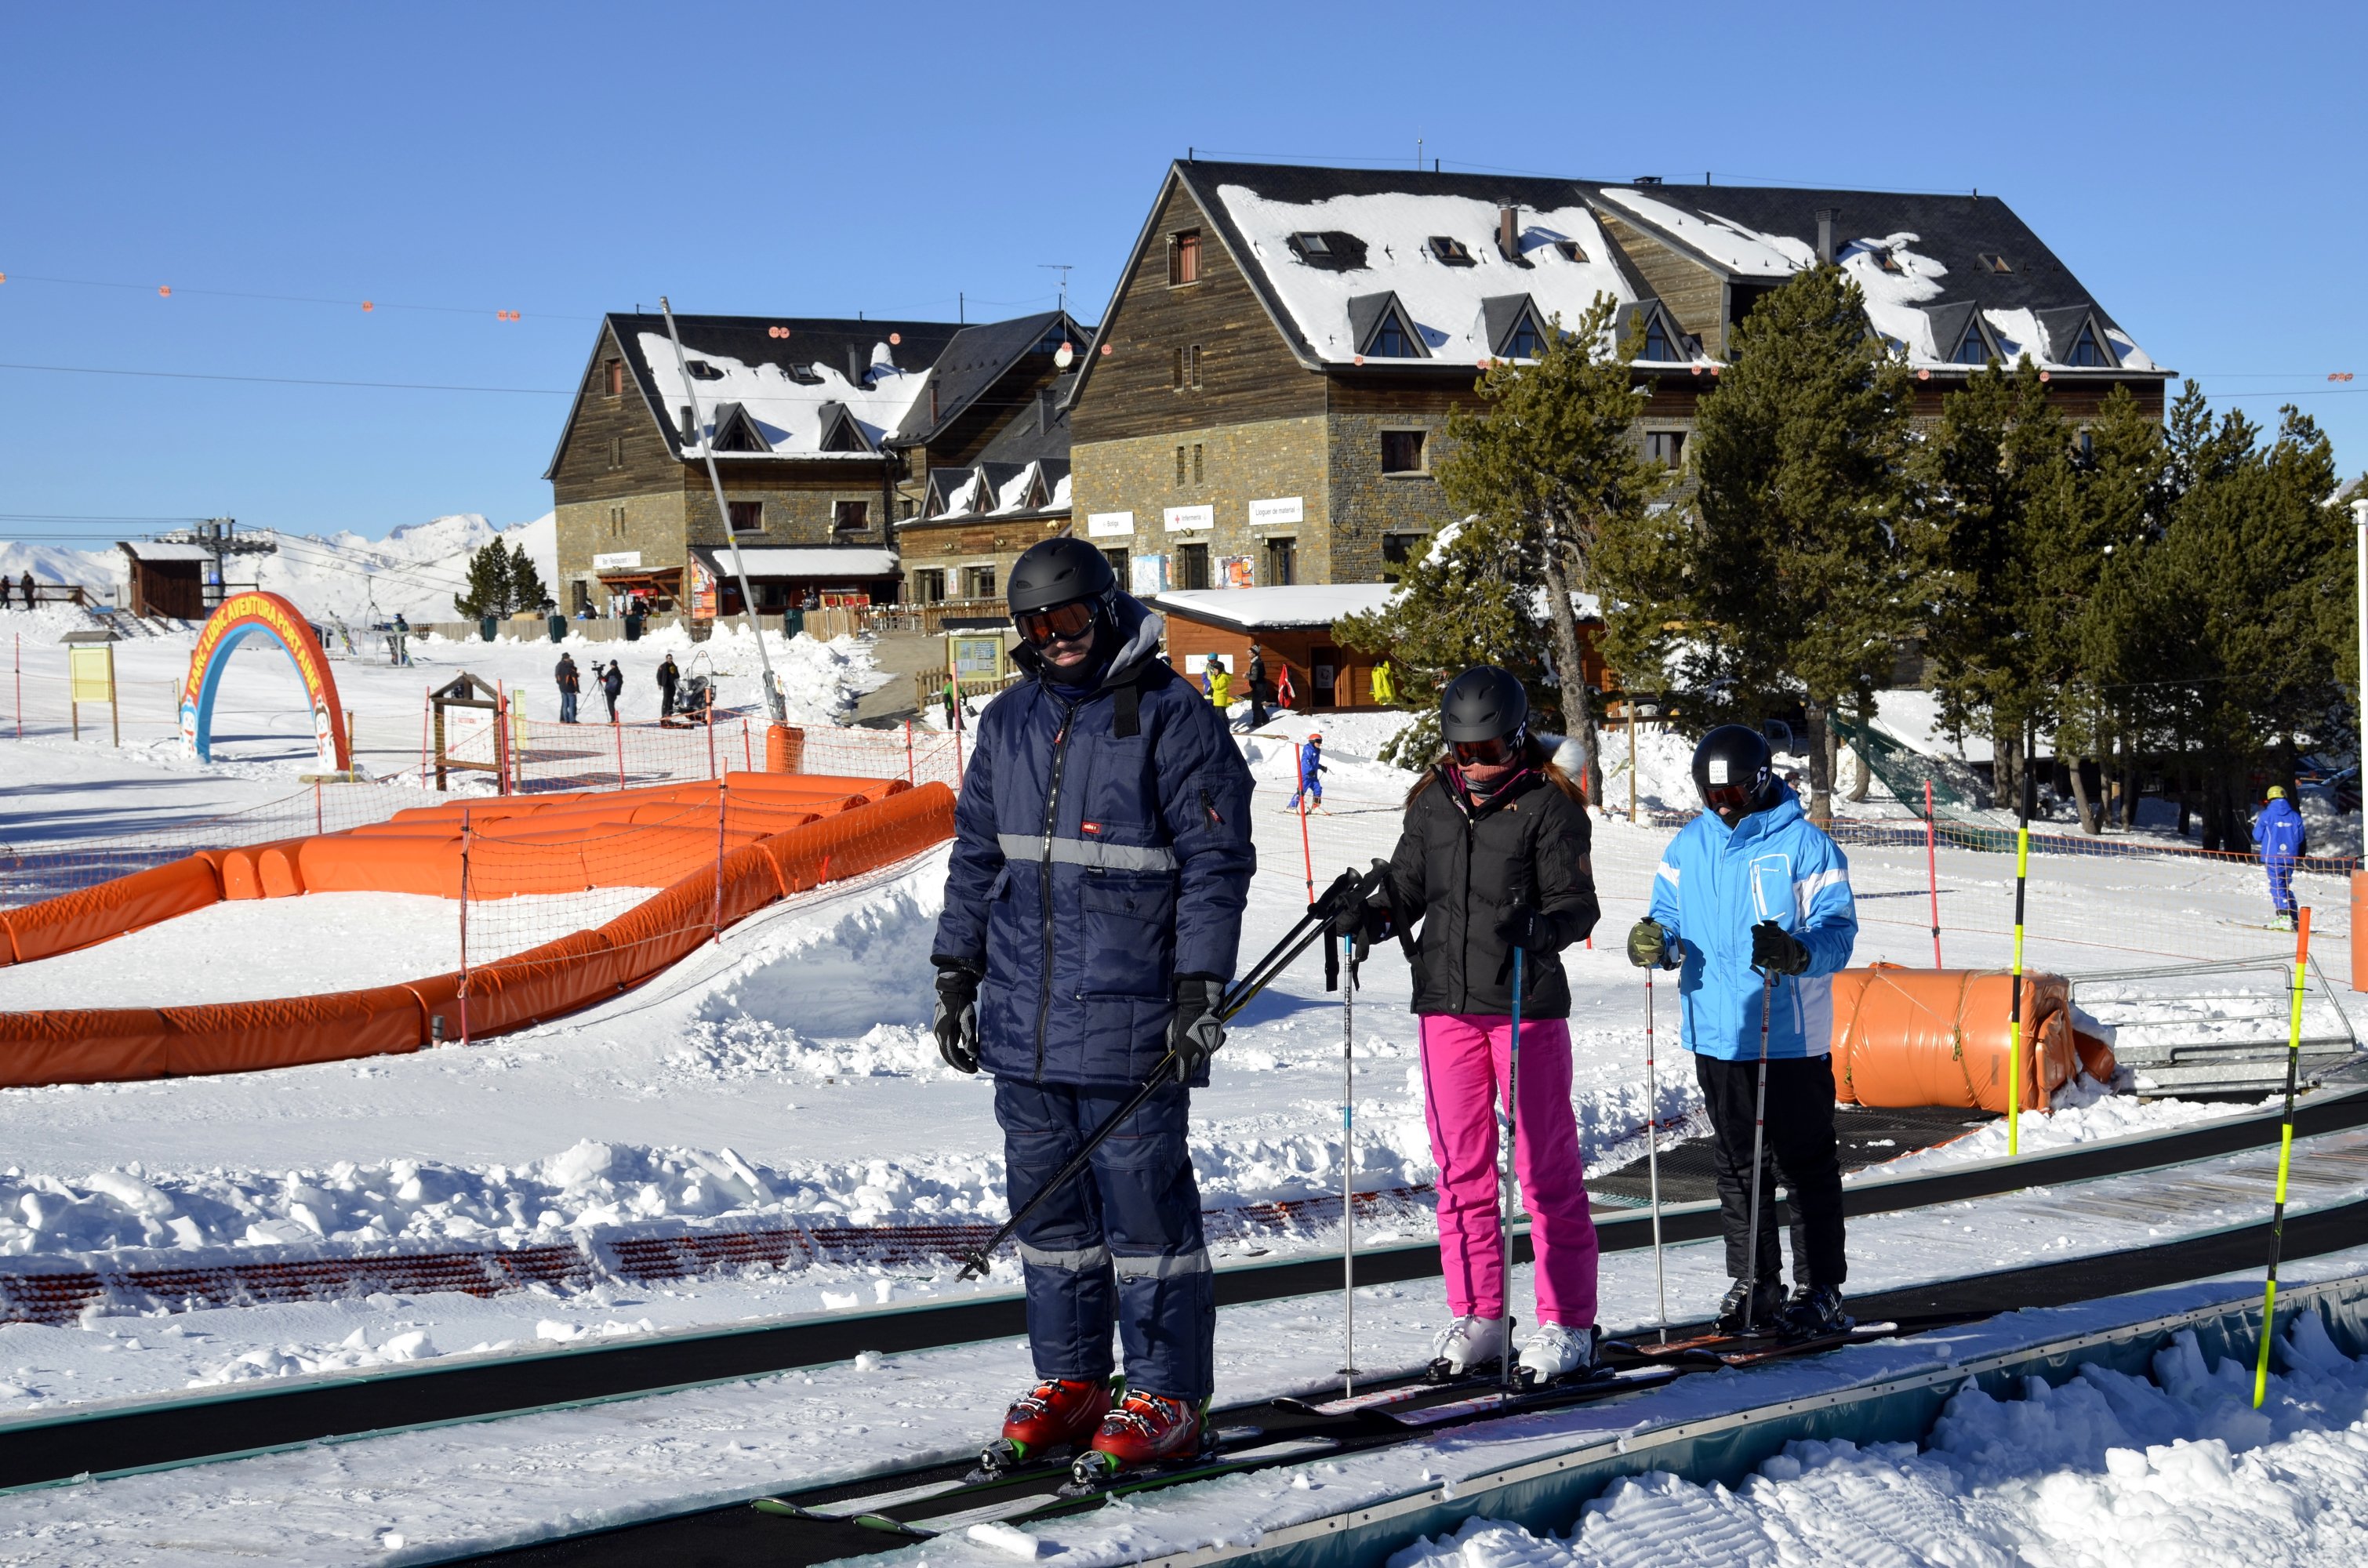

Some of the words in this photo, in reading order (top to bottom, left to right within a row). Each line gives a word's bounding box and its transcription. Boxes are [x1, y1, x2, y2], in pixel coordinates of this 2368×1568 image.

[188, 644, 208, 695] PARC
[227, 595, 277, 626] AVENTURA
[276, 612, 302, 654] PORT
